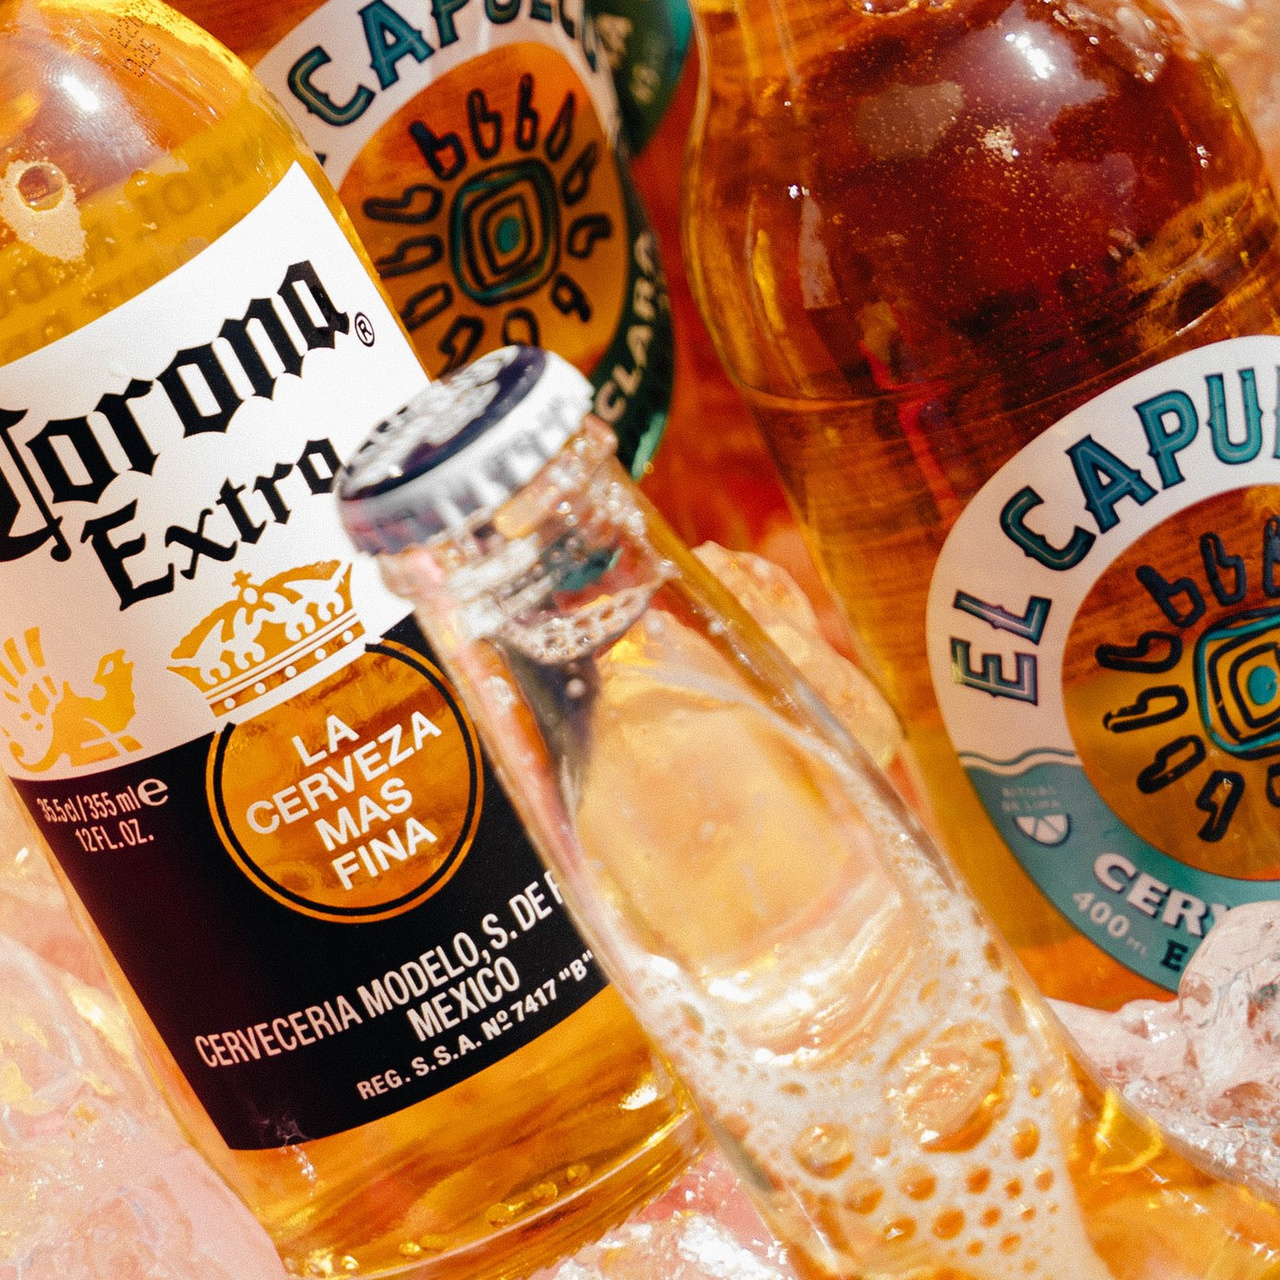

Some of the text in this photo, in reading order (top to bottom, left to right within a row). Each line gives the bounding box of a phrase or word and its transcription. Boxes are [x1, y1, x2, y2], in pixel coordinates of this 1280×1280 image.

[81, 437, 344, 612] Extra
[951, 365, 1280, 706] EL CAPU
[246, 710, 443, 836] CERVEZA
[292, 714, 360, 767] LA
[314, 776, 414, 852] MAS
[331, 816, 438, 891] FINA
[194, 994, 363, 1069] CERVECERIA
[355, 931, 493, 1020] MODELO,
[481, 912, 518, 948] S.
[508, 880, 552, 932] DE
[406, 956, 521, 1043] MEXICO
[355, 1068, 412, 1101] REG.
[511, 978, 559, 1024] 7417
